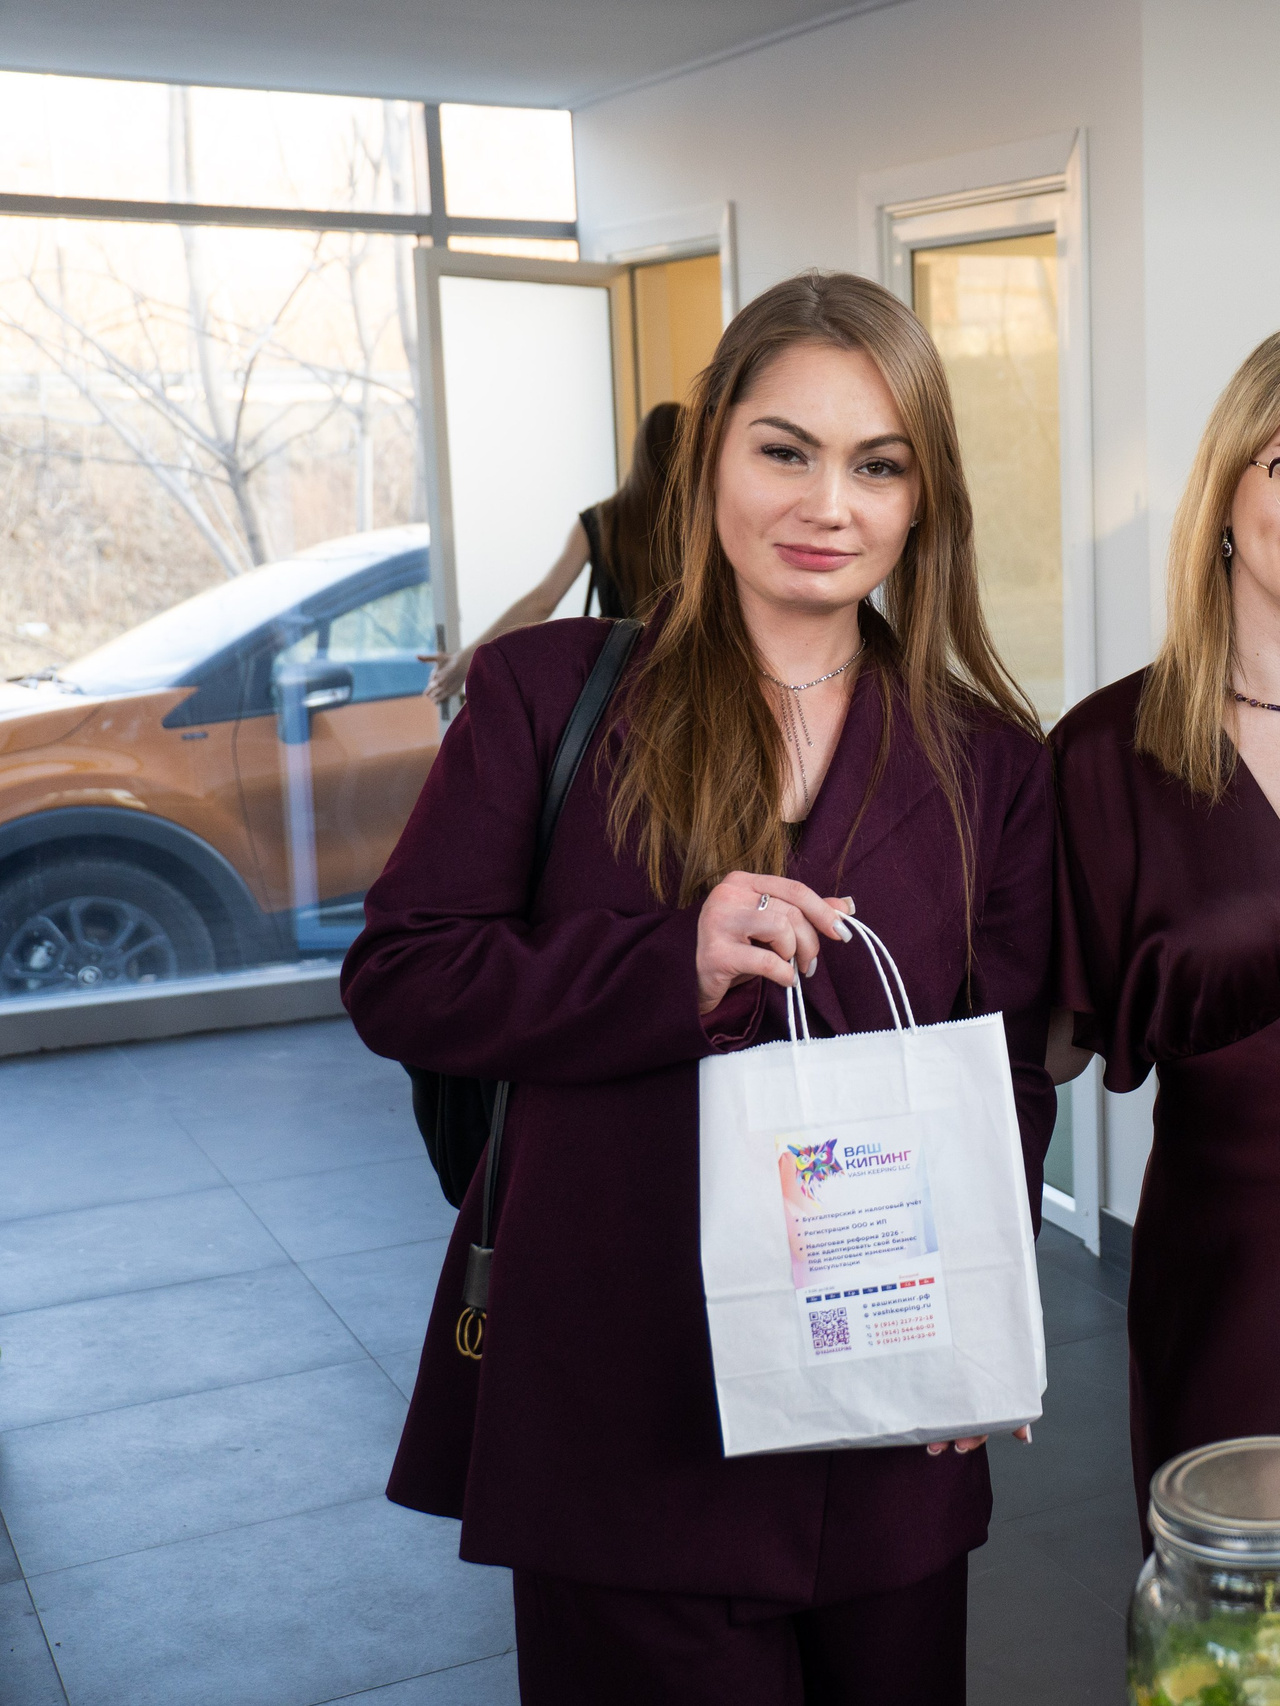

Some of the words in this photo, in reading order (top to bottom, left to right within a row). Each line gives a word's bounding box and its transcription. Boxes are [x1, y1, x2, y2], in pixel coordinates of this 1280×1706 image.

[844, 1142, 882, 1158] ВАШ
[845, 1149, 912, 1170] КИПИНГ
[847, 1170, 866, 1178] VASH
[867, 1166, 897, 1176] KEEPING
[898, 1163, 911, 1171] LLC
[802, 1210, 856, 1223] Бухгалтерский
[864, 1202, 904, 1214] налоговый
[906, 1199, 922, 1208] учёт
[804, 1225, 850, 1237] Регистрация
[806, 1239, 845, 1250] Налоговая
[846, 1234, 879, 1245] реформа
[881, 1230, 899, 1238] 2026
[822, 1243, 871, 1256] адаптировать
[891, 1235, 918, 1244] бизнес
[823, 1252, 863, 1263] налоговые
[809, 1260, 860, 1272] Консультации
[871, 1293, 931, 1307] вашкипинг.рф
[873, 1302, 931, 1316] vashkeeping.ru
